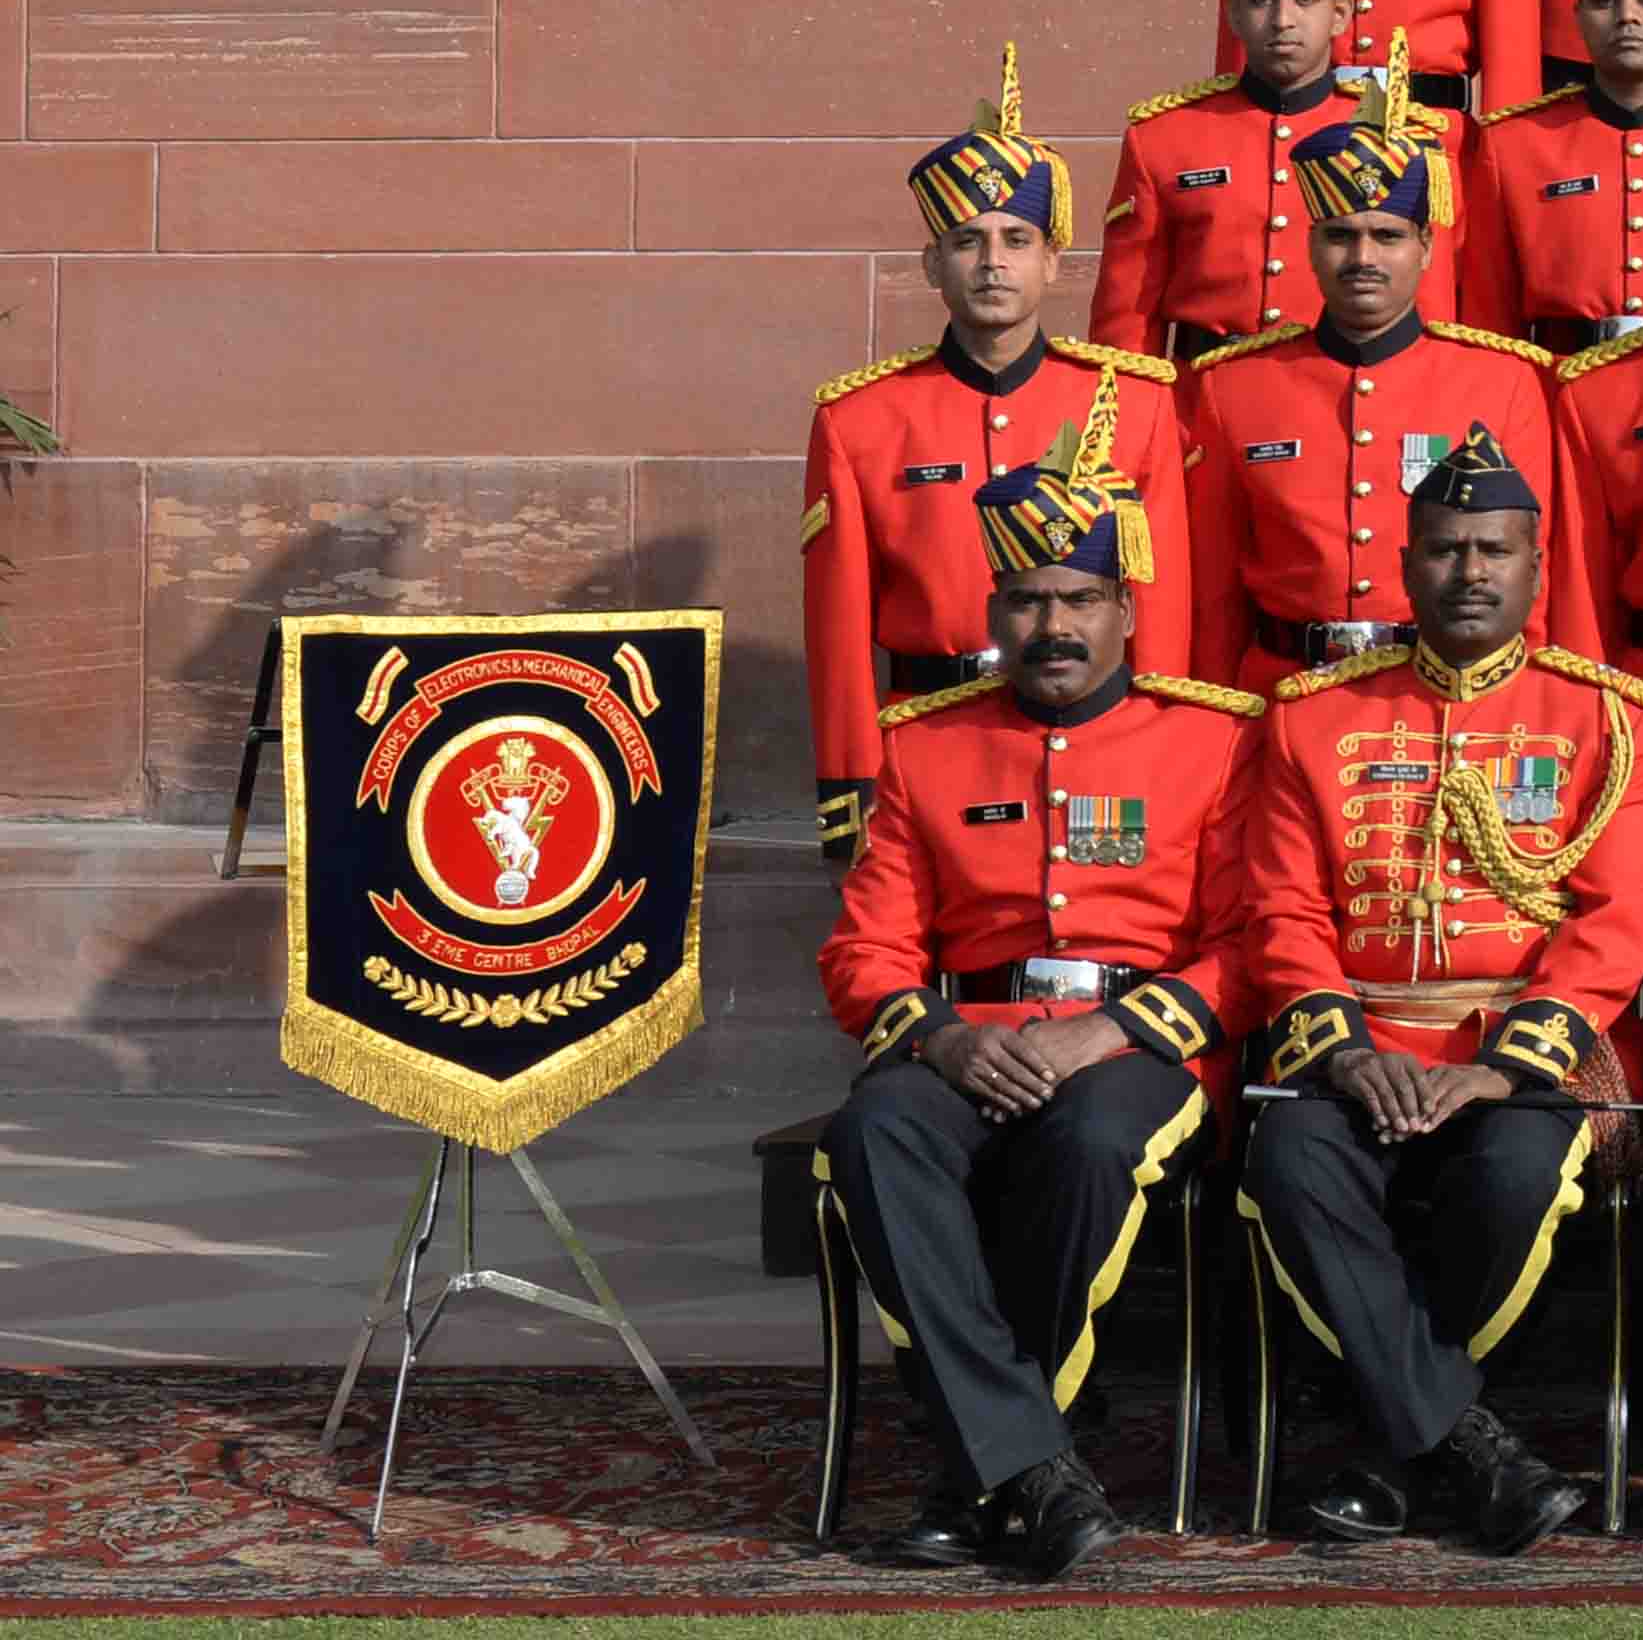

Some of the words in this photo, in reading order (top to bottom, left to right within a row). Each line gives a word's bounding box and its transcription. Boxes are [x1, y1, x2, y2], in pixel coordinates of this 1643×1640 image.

[372, 728, 407, 779] CORPS
[404, 708, 421, 729] OF
[424, 659, 511, 698] ELECTRONICS
[597, 697, 648, 769] ENGINEERS
[416, 930, 430, 944] 3
[428, 939, 465, 963] EME
[473, 952, 534, 969] CENTRE
[545, 926, 601, 960] BHOPAL
